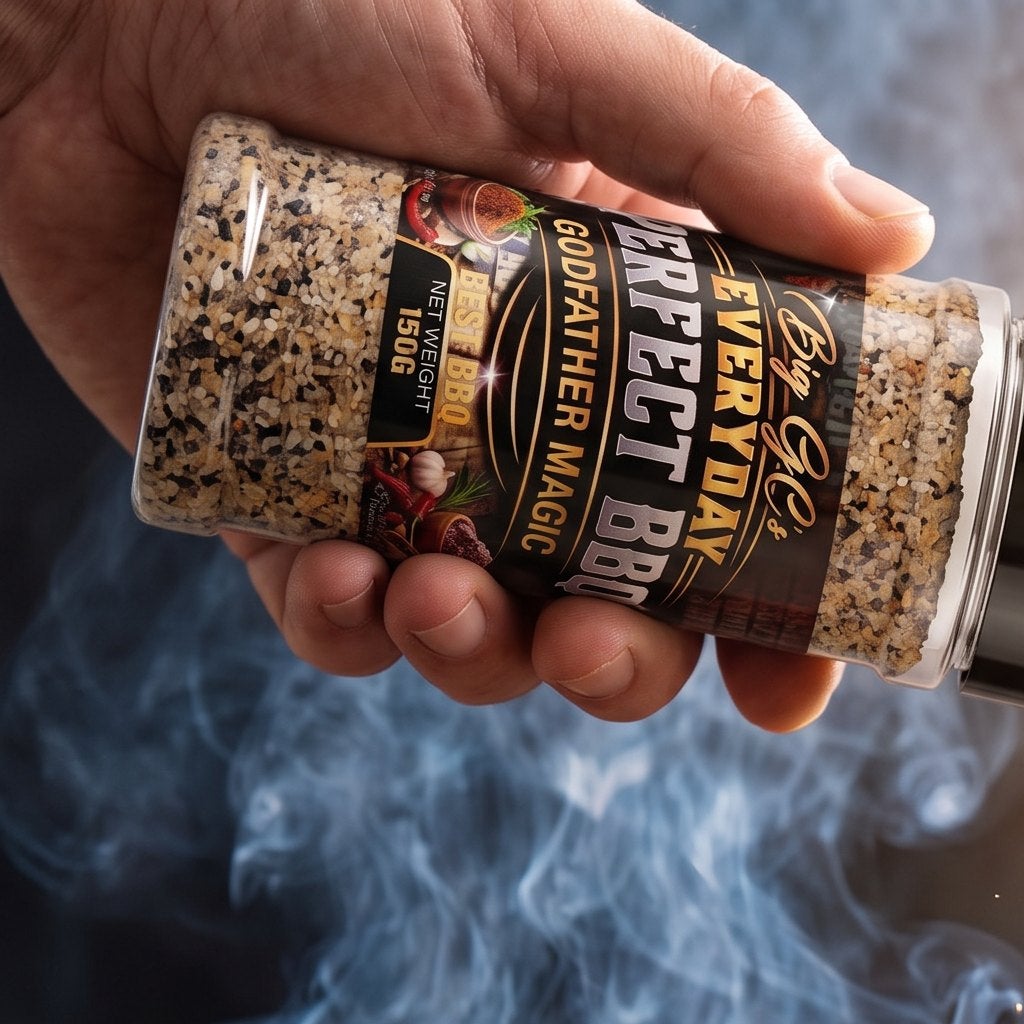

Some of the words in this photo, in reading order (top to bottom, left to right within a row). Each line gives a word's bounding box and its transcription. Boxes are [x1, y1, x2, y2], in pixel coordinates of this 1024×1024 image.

[390, 307, 423, 376] 150G
[427, 280, 447, 322] NET
[450, 268, 489, 355] BEST
[552, 218, 599, 432] GODFATHER
[598, 207, 702, 484] PERFECT
[769, 290, 837, 402] Big
[414, 327, 441, 414] WEIGHT
[438, 356, 480, 426] BBQ
[683, 273, 764, 566] EVERYDAY
[520, 440, 582, 557] MAGIC
[554, 494, 686, 607] BBQ
